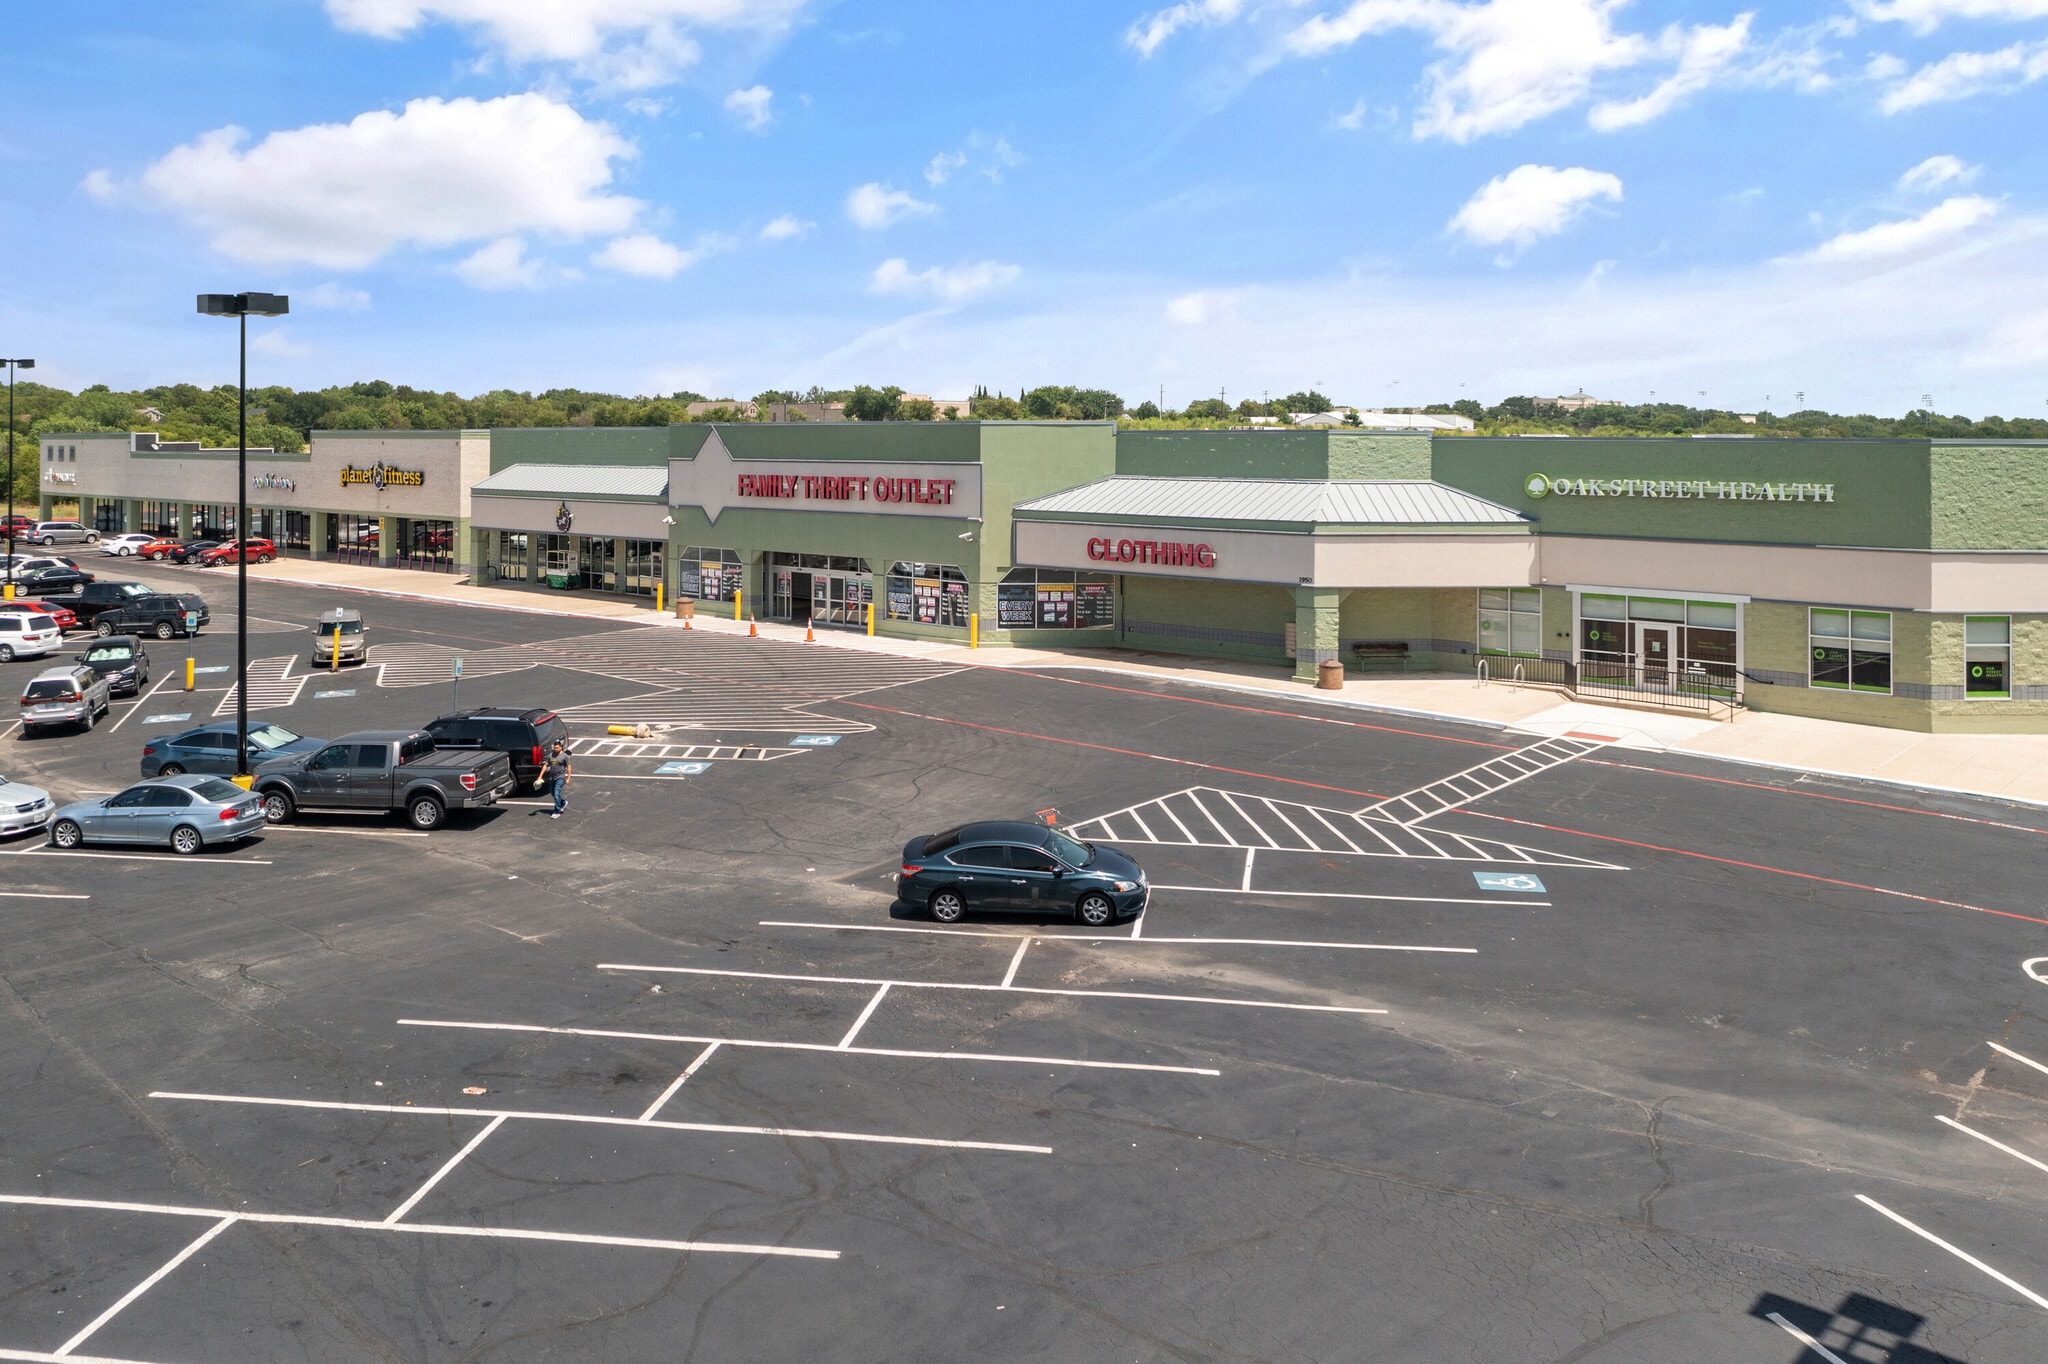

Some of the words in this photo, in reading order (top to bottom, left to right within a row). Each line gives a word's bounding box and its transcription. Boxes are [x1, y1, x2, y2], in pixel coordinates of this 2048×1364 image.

[340, 465, 373, 487] planet
[383, 467, 422, 485] fitness
[737, 473, 798, 498] FAMILY
[801, 475, 869, 501] THRIFT
[872, 476, 955, 505] OUTLET
[1552, 478, 1605, 497] OAK
[1609, 479, 1711, 499] STREET
[1716, 481, 1835, 502] HEALTH
[1087, 537, 1214, 568] CLOTHING
[999, 600, 1034, 610] EVERY
[1000, 610, 1032, 620] WEEK
